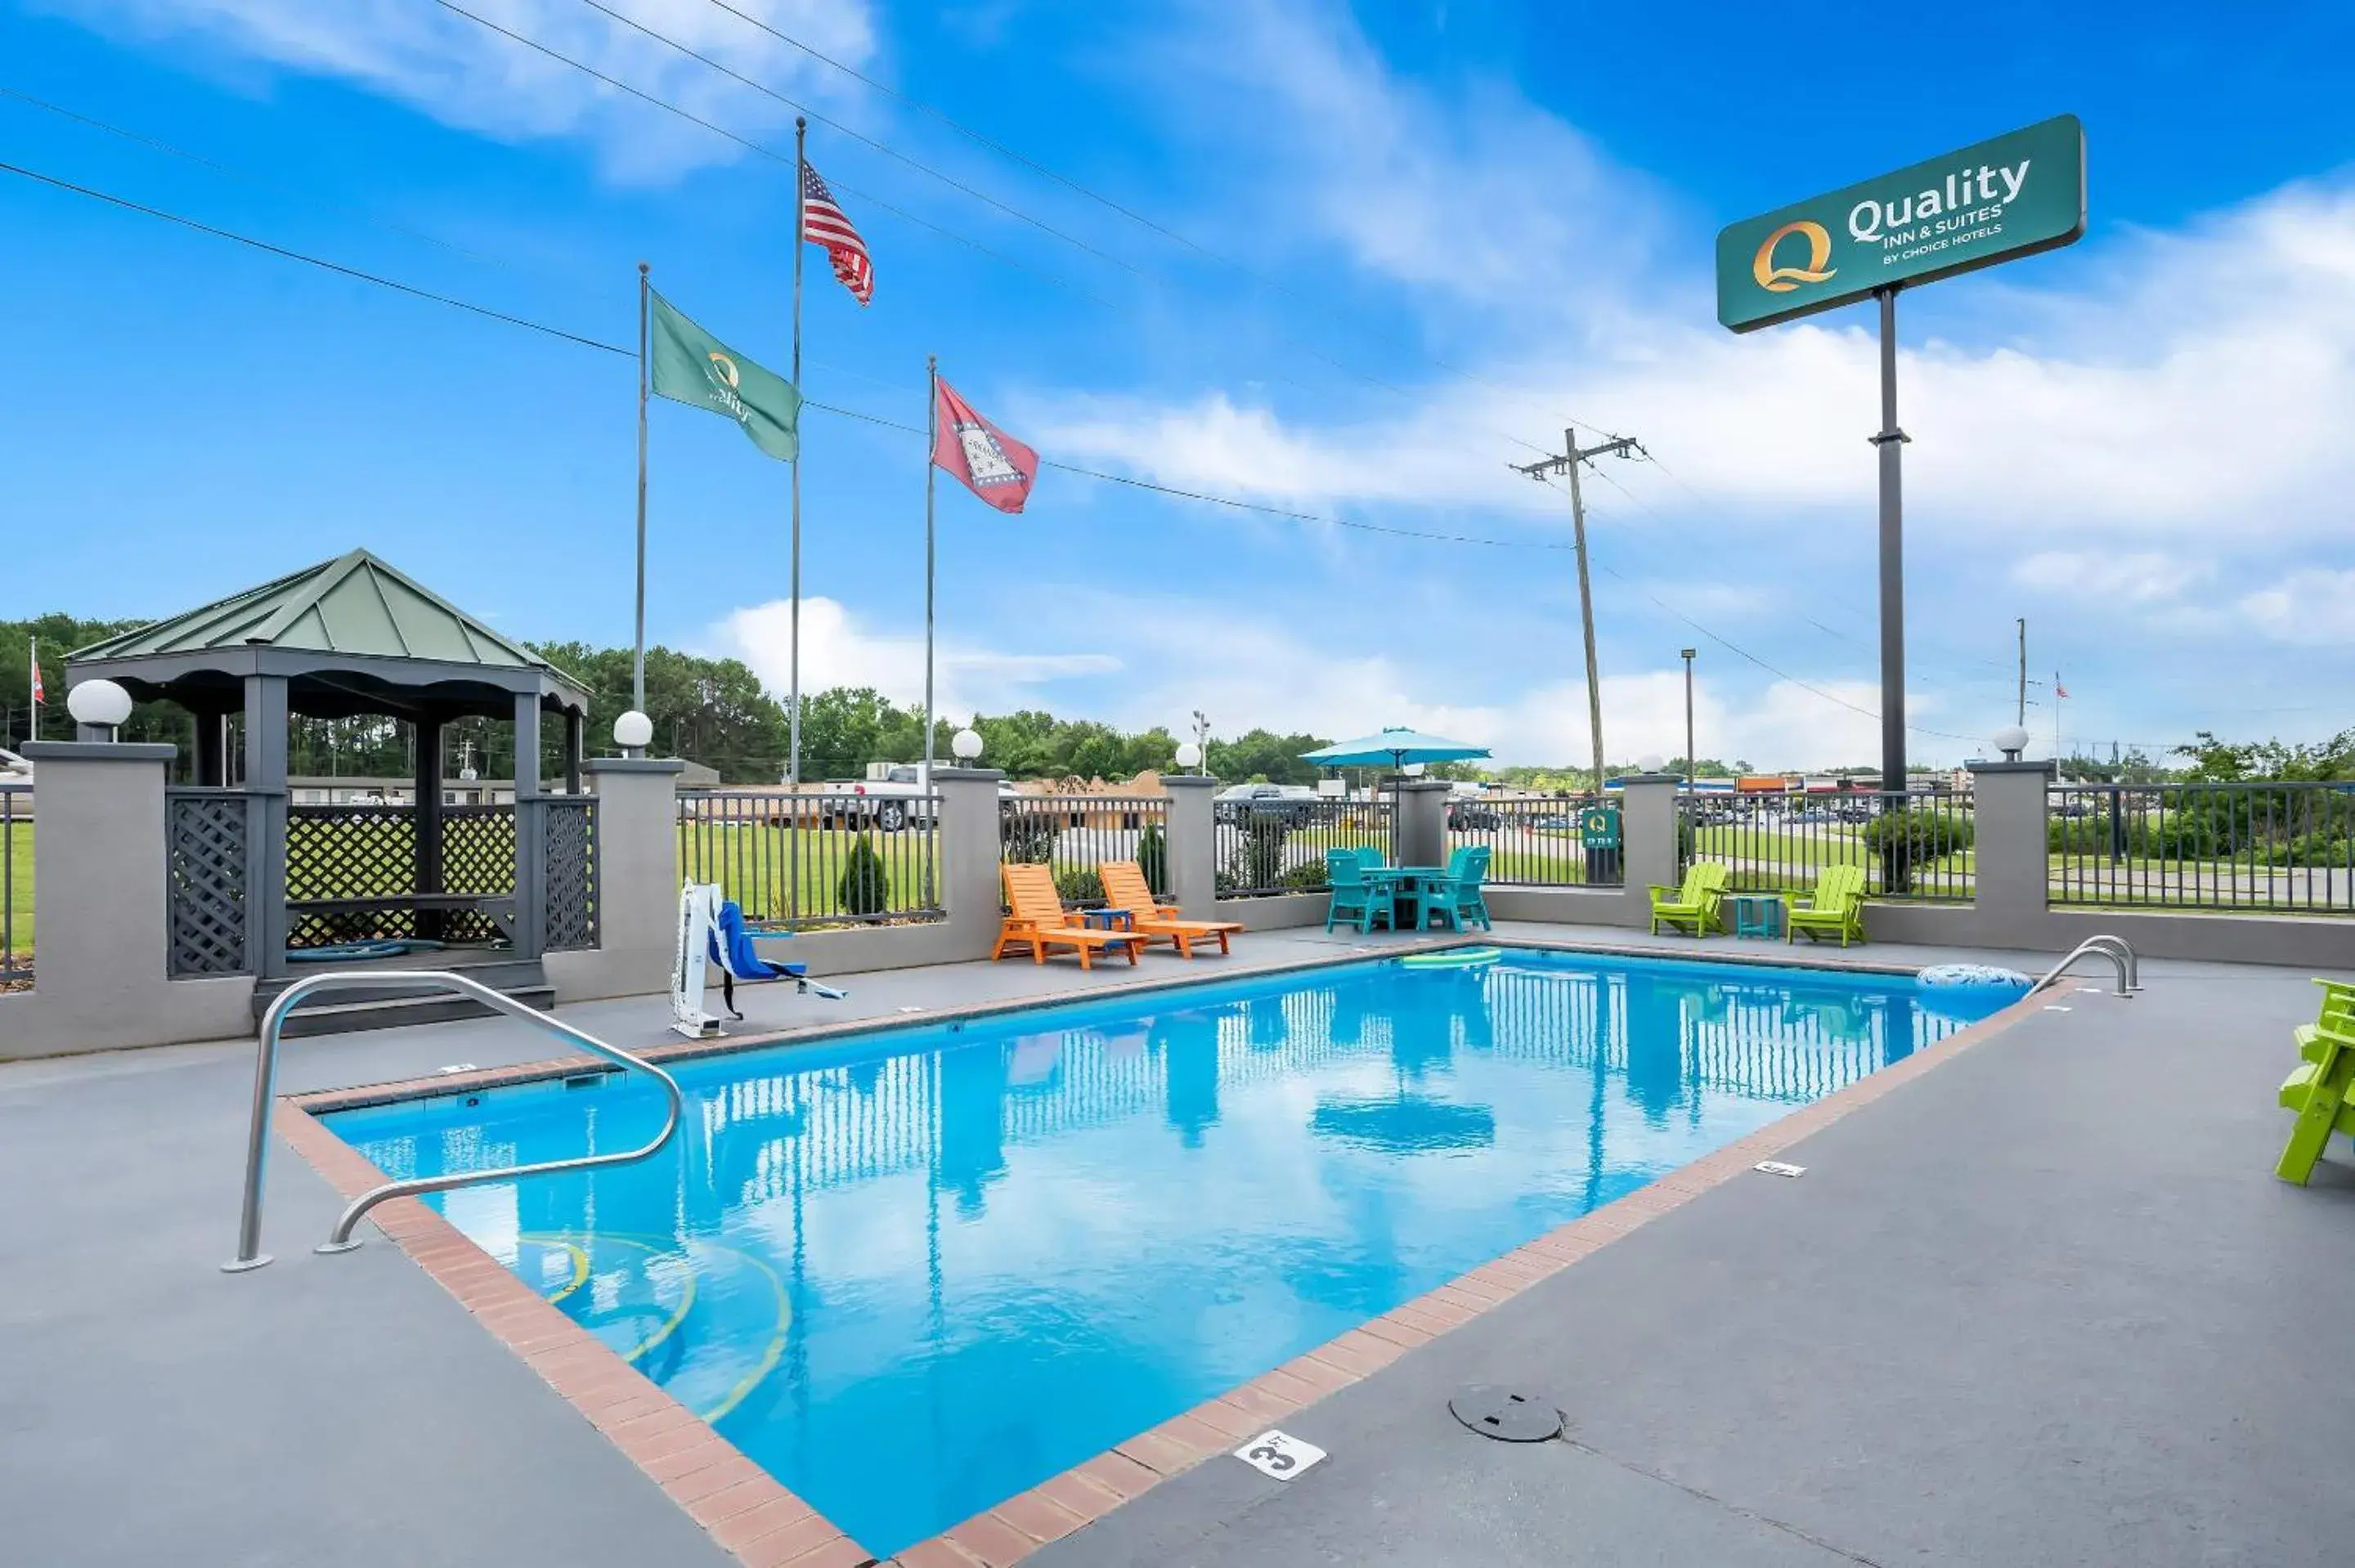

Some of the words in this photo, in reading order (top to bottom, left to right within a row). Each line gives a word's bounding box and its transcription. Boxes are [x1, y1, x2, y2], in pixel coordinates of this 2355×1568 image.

[1848, 159, 2031, 243] Quality
[1883, 230, 1915, 249] INN
[1919, 226, 1931, 239] &
[1935, 204, 2003, 233] SUITES
[1883, 253, 1900, 265] BY
[1902, 240, 1949, 260] CHOICE
[1952, 223, 2003, 245] HOTELS
[1249, 1446, 1296, 1471] 3
